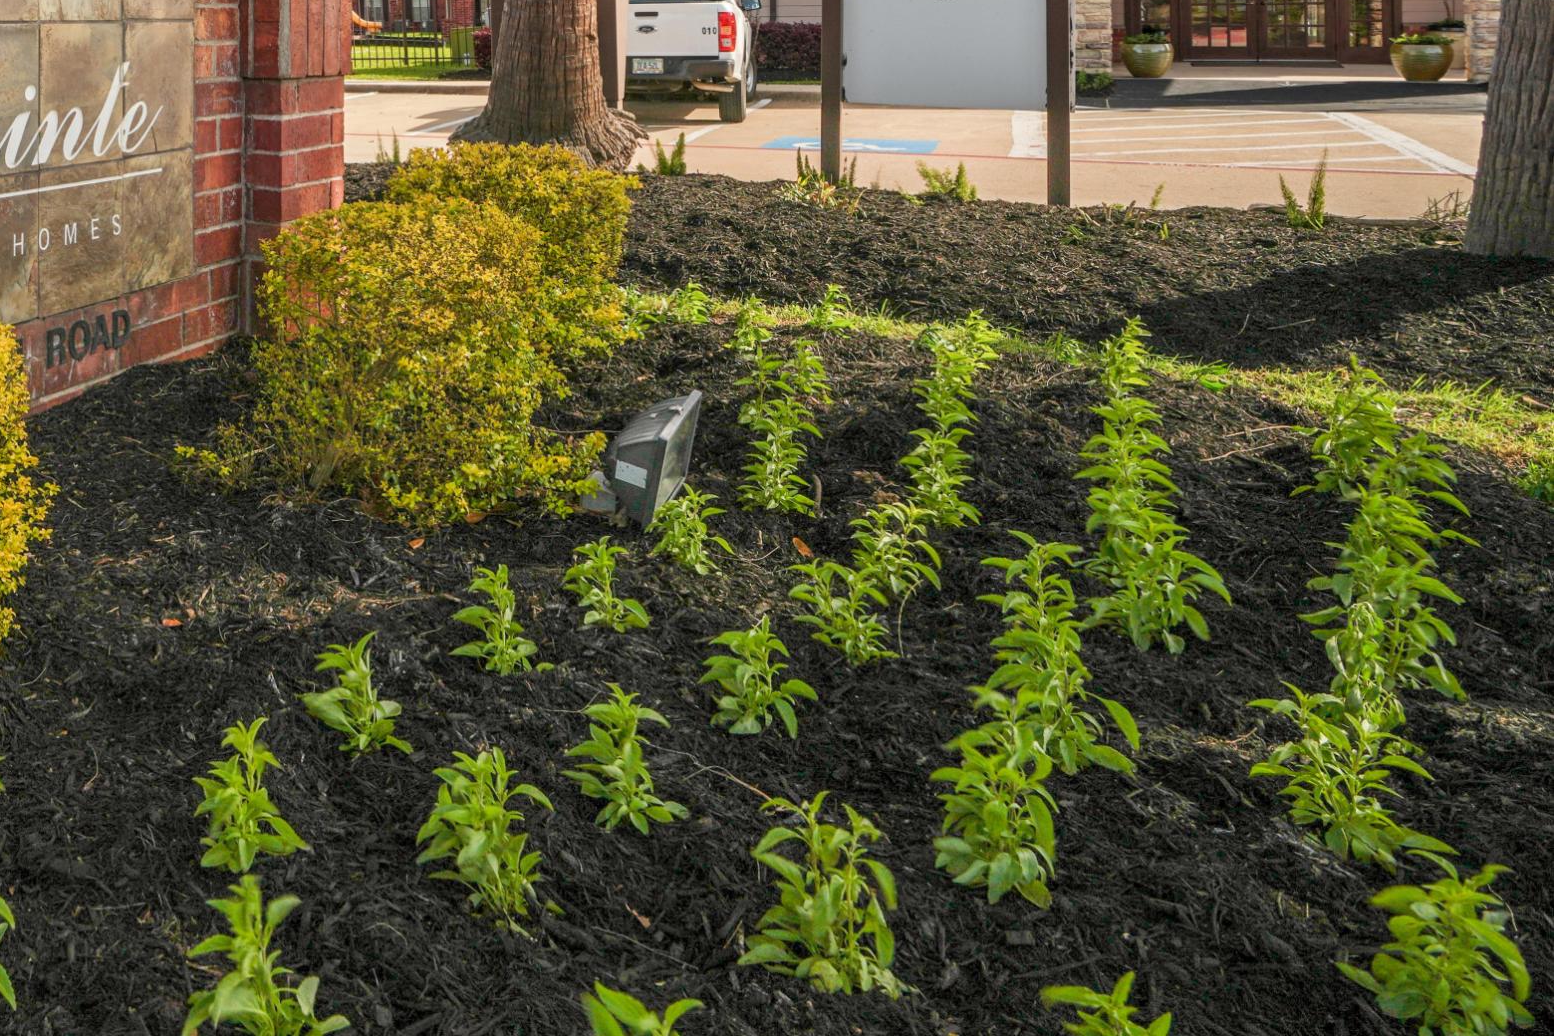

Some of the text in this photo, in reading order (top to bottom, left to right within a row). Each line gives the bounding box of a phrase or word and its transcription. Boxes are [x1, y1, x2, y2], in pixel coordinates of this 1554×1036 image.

[701, 27, 717, 35] 010
[12, 214, 122, 257] HOMES
[45, 308, 132, 370] ROAD
